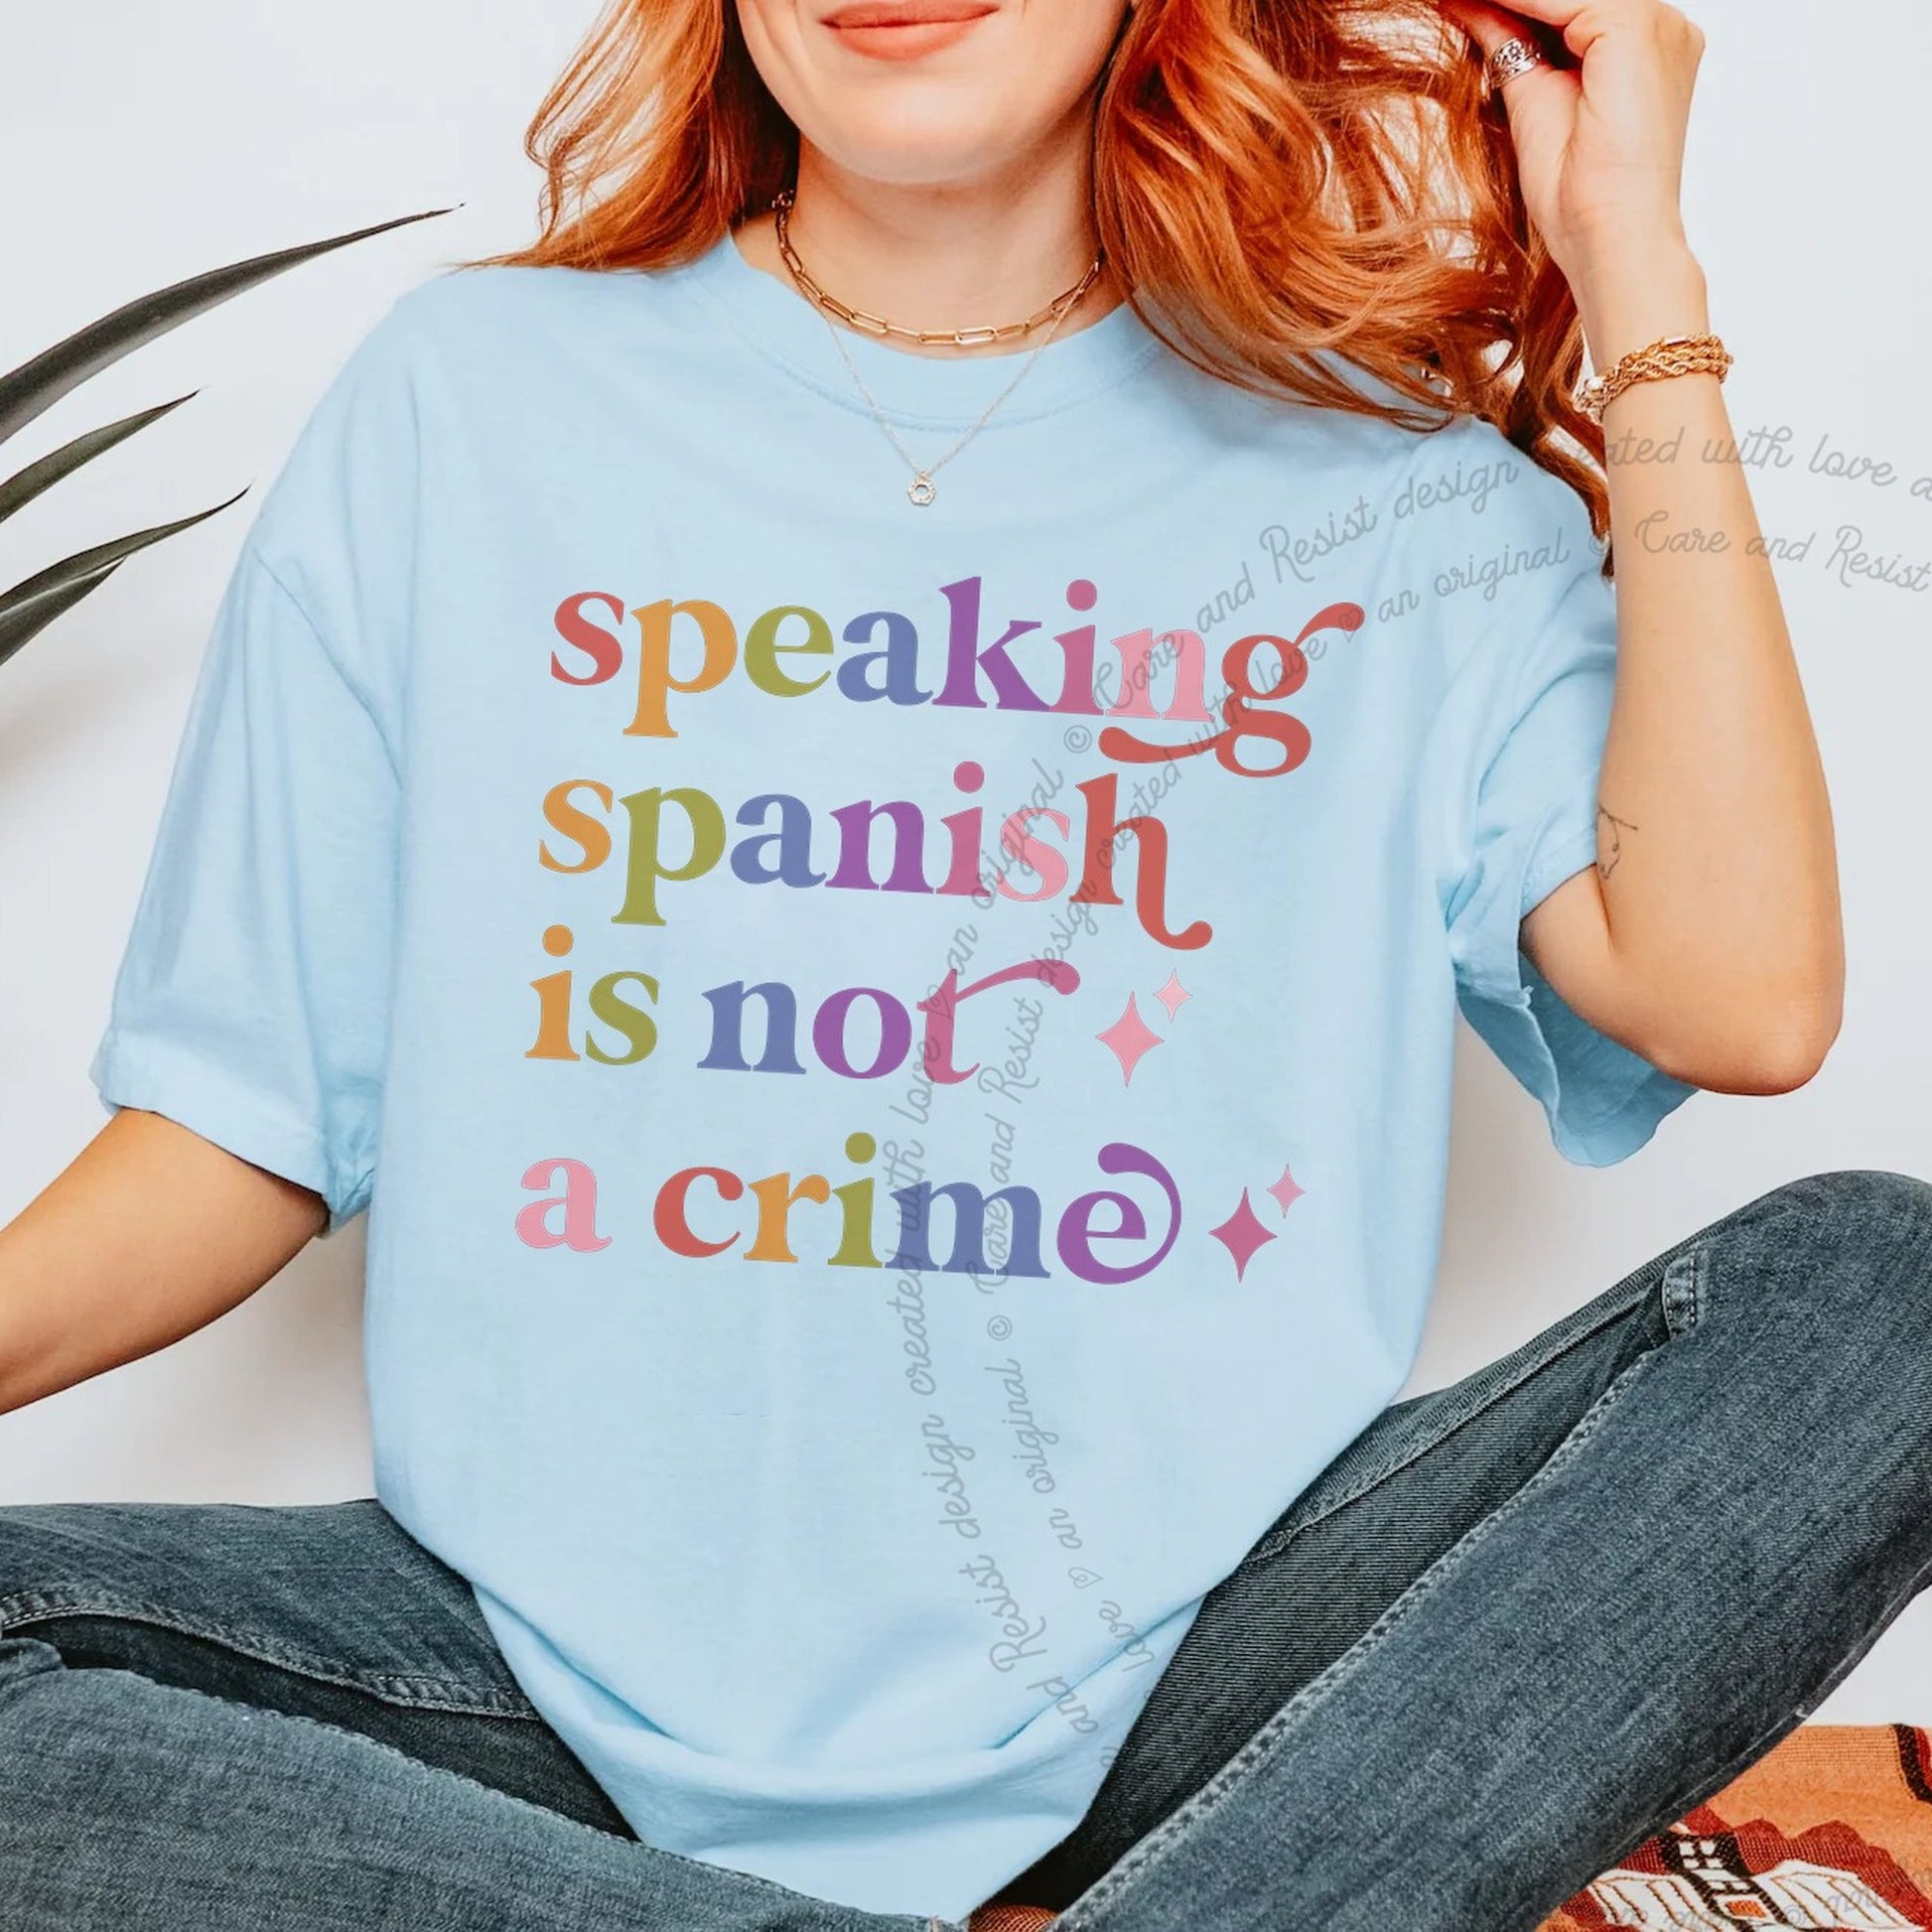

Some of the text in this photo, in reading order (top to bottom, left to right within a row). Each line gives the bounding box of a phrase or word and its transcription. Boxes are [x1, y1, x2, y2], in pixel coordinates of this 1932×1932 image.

[551, 576, 1365, 777] speaking
[538, 760, 1213, 950] spanish
[524, 924, 1081, 1084] is not
[513, 1132, 1181, 1285] a crime
